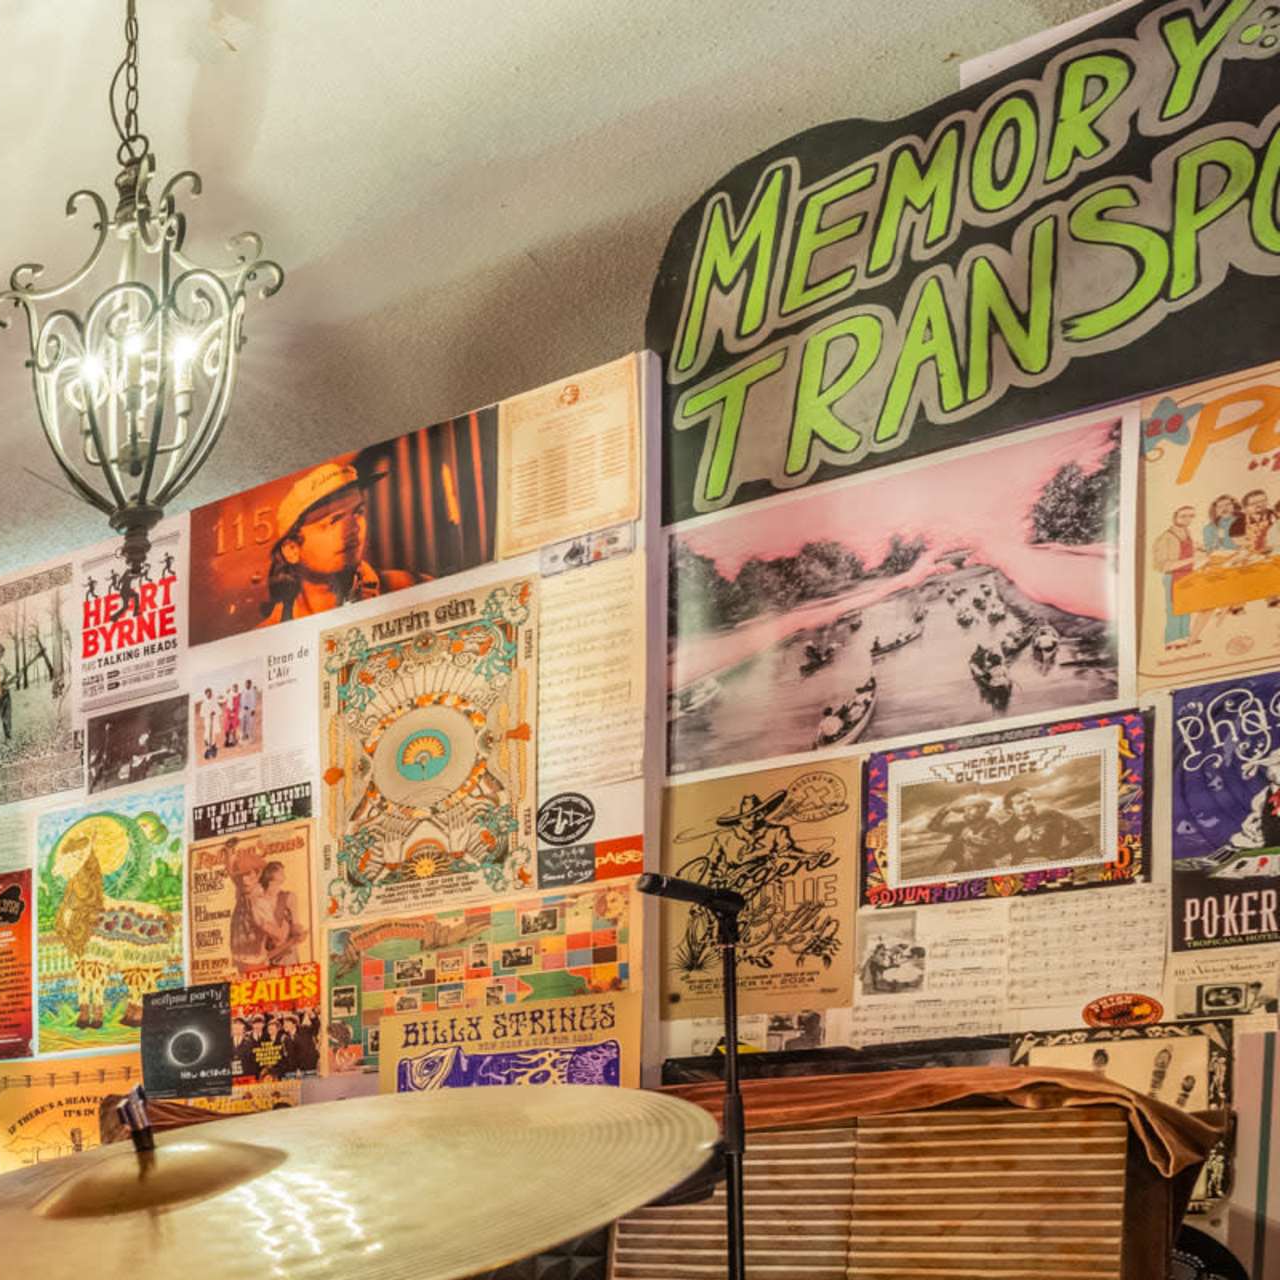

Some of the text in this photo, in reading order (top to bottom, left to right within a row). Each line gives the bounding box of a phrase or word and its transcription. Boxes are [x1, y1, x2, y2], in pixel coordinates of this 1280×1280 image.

[676, 0, 1242, 371] MEMORY
[212, 507, 273, 557] 115
[81, 605, 178, 659] BYRNE
[97, 648, 141, 668] TALKING
[143, 638, 178, 656] HEADS
[297, 646, 309, 661] de
[210, 815, 223, 831] IT
[1184, 888, 1279, 940] POKER
[230, 974, 318, 1007] BEATLES
[402, 1015, 484, 1049] BILLY
[492, 1001, 617, 1041] STRINGS
[17, 1102, 55, 1127] THERE'S
[54, 1100, 65, 1109] A
[63, 1108, 82, 1118] IT'S
